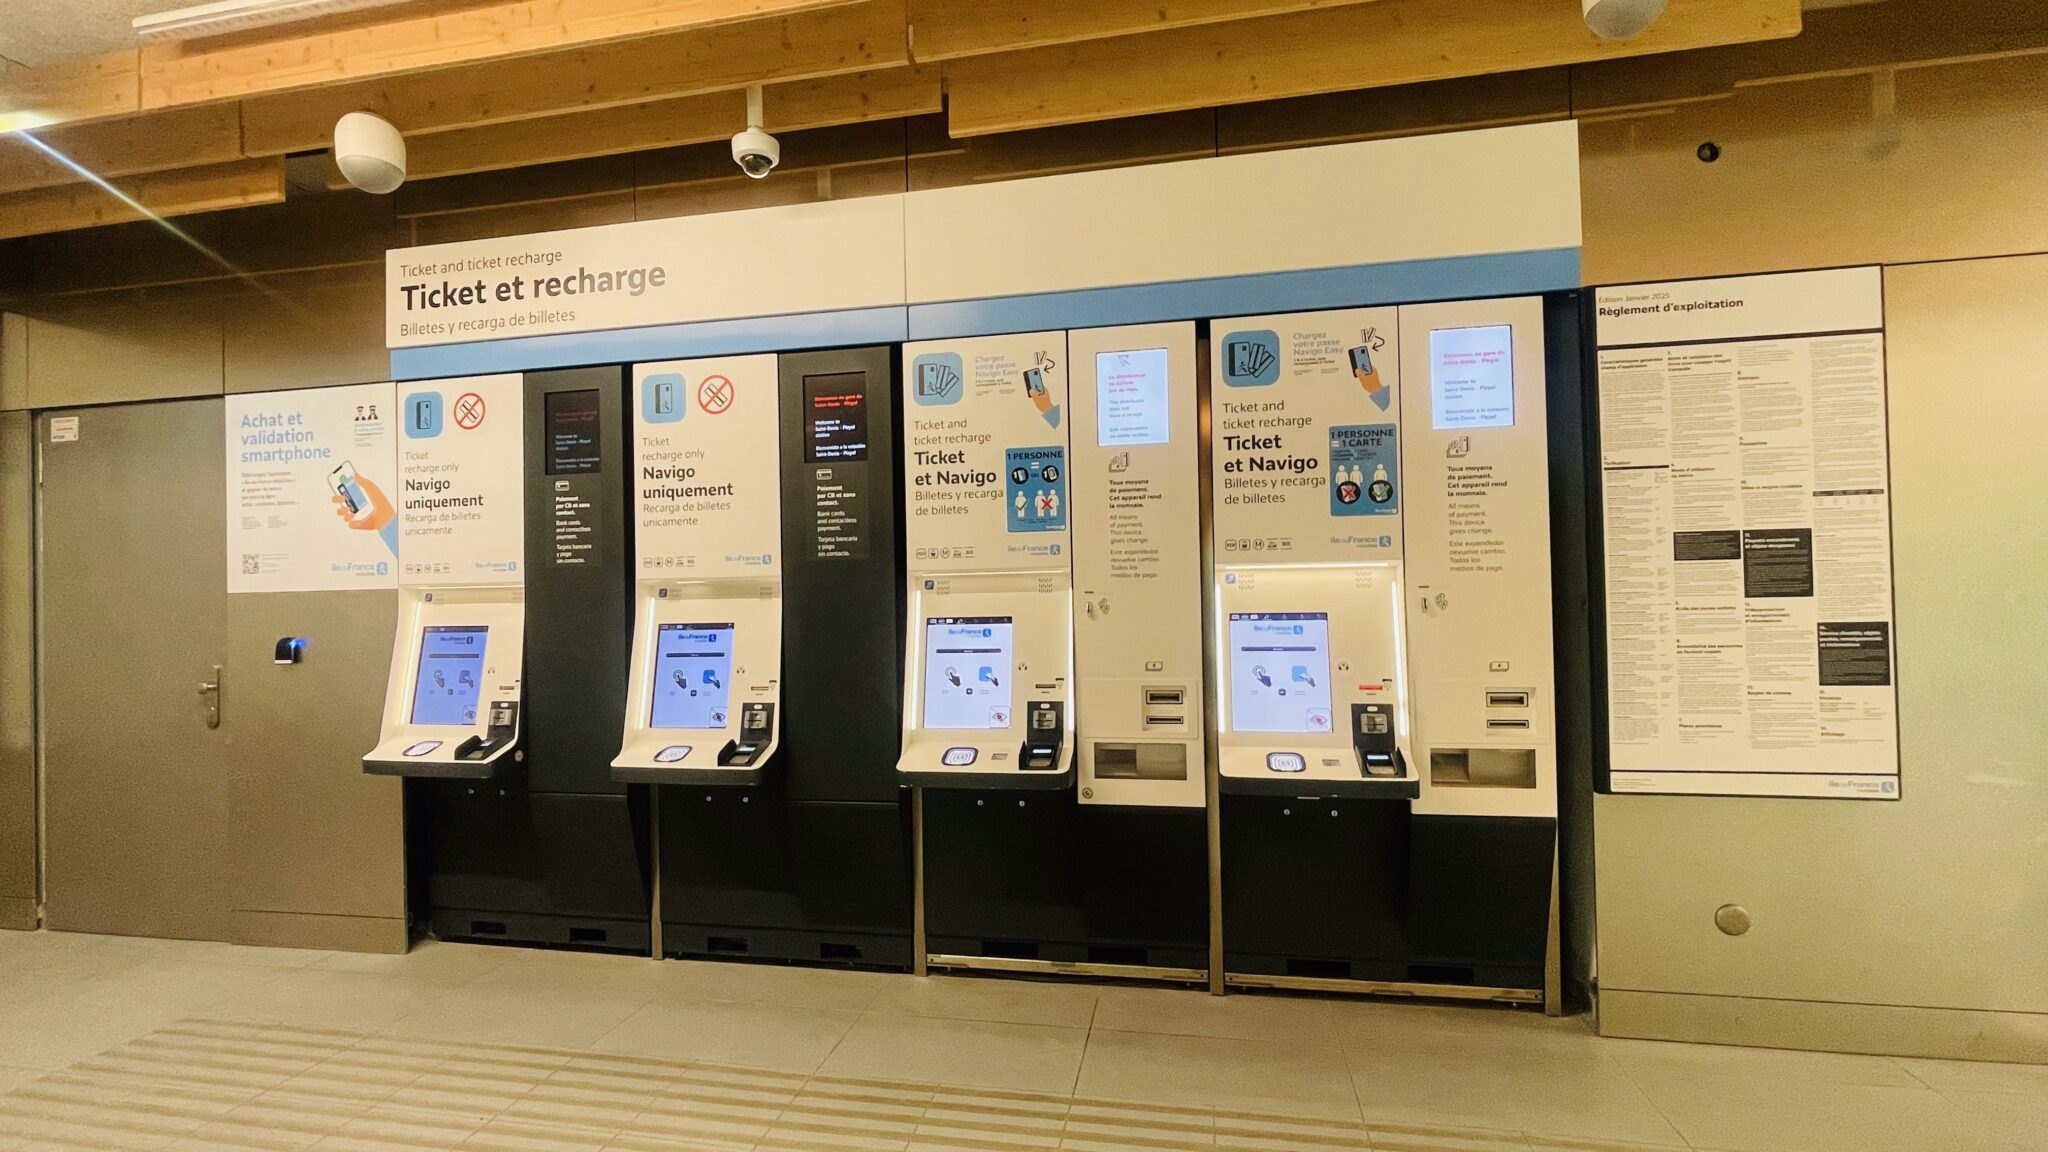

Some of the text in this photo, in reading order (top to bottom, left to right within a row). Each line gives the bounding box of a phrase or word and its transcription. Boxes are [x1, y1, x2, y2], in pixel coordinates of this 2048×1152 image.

[401, 250, 562, 278] Ticket and ticket recharge
[401, 266, 666, 310] Ticket et recharge
[1599, 304, 1660, 317] Règlement
[401, 310, 575, 336] Billetes y recarga de billetes
[1293, 332, 1326, 341] Chargez
[1294, 346, 1344, 357] Navigo Easy
[976, 355, 1004, 363] Chargez
[976, 369, 1019, 378] Navigo Easy
[1223, 400, 1284, 413] Ticket and
[241, 412, 302, 428] Achat et
[914, 418, 967, 430] Ticket and
[1223, 416, 1312, 429] ticket recharge
[241, 429, 313, 445] validation
[914, 432, 991, 445] ticket recharge
[1338, 429, 1394, 438] PERSONNE
[642, 437, 669, 446] Ticket
[1223, 435, 1282, 450] Ticket
[1349, 438, 1382, 447] CARTE
[241, 446, 331, 463] smartphone
[405, 452, 428, 460] Ticket
[642, 449, 704, 461] recharge only
[914, 450, 965, 465] Ticket
[1014, 450, 1063, 460] PERSONNE
[405, 463, 458, 474] recharge only
[1224, 459, 1243, 472] et
[1250, 455, 1317, 473] Navigo
[643, 465, 695, 481] Navigo
[915, 470, 996, 487] et Navigo
[406, 478, 450, 493] Navigo
[1224, 476, 1325, 489] Billetes y recarga
[643, 483, 734, 501] uniquement
[916, 489, 1003, 501] Billetes y recarga
[1224, 492, 1285, 504] de billetes
[406, 495, 483, 511] uniquement
[644, 501, 731, 514] Recarga de billetes
[916, 504, 968, 515] de billetes
[405, 512, 481, 524] Recarga de billetes
[643, 517, 698, 527] unicamente
[405, 527, 452, 535] unicamente
